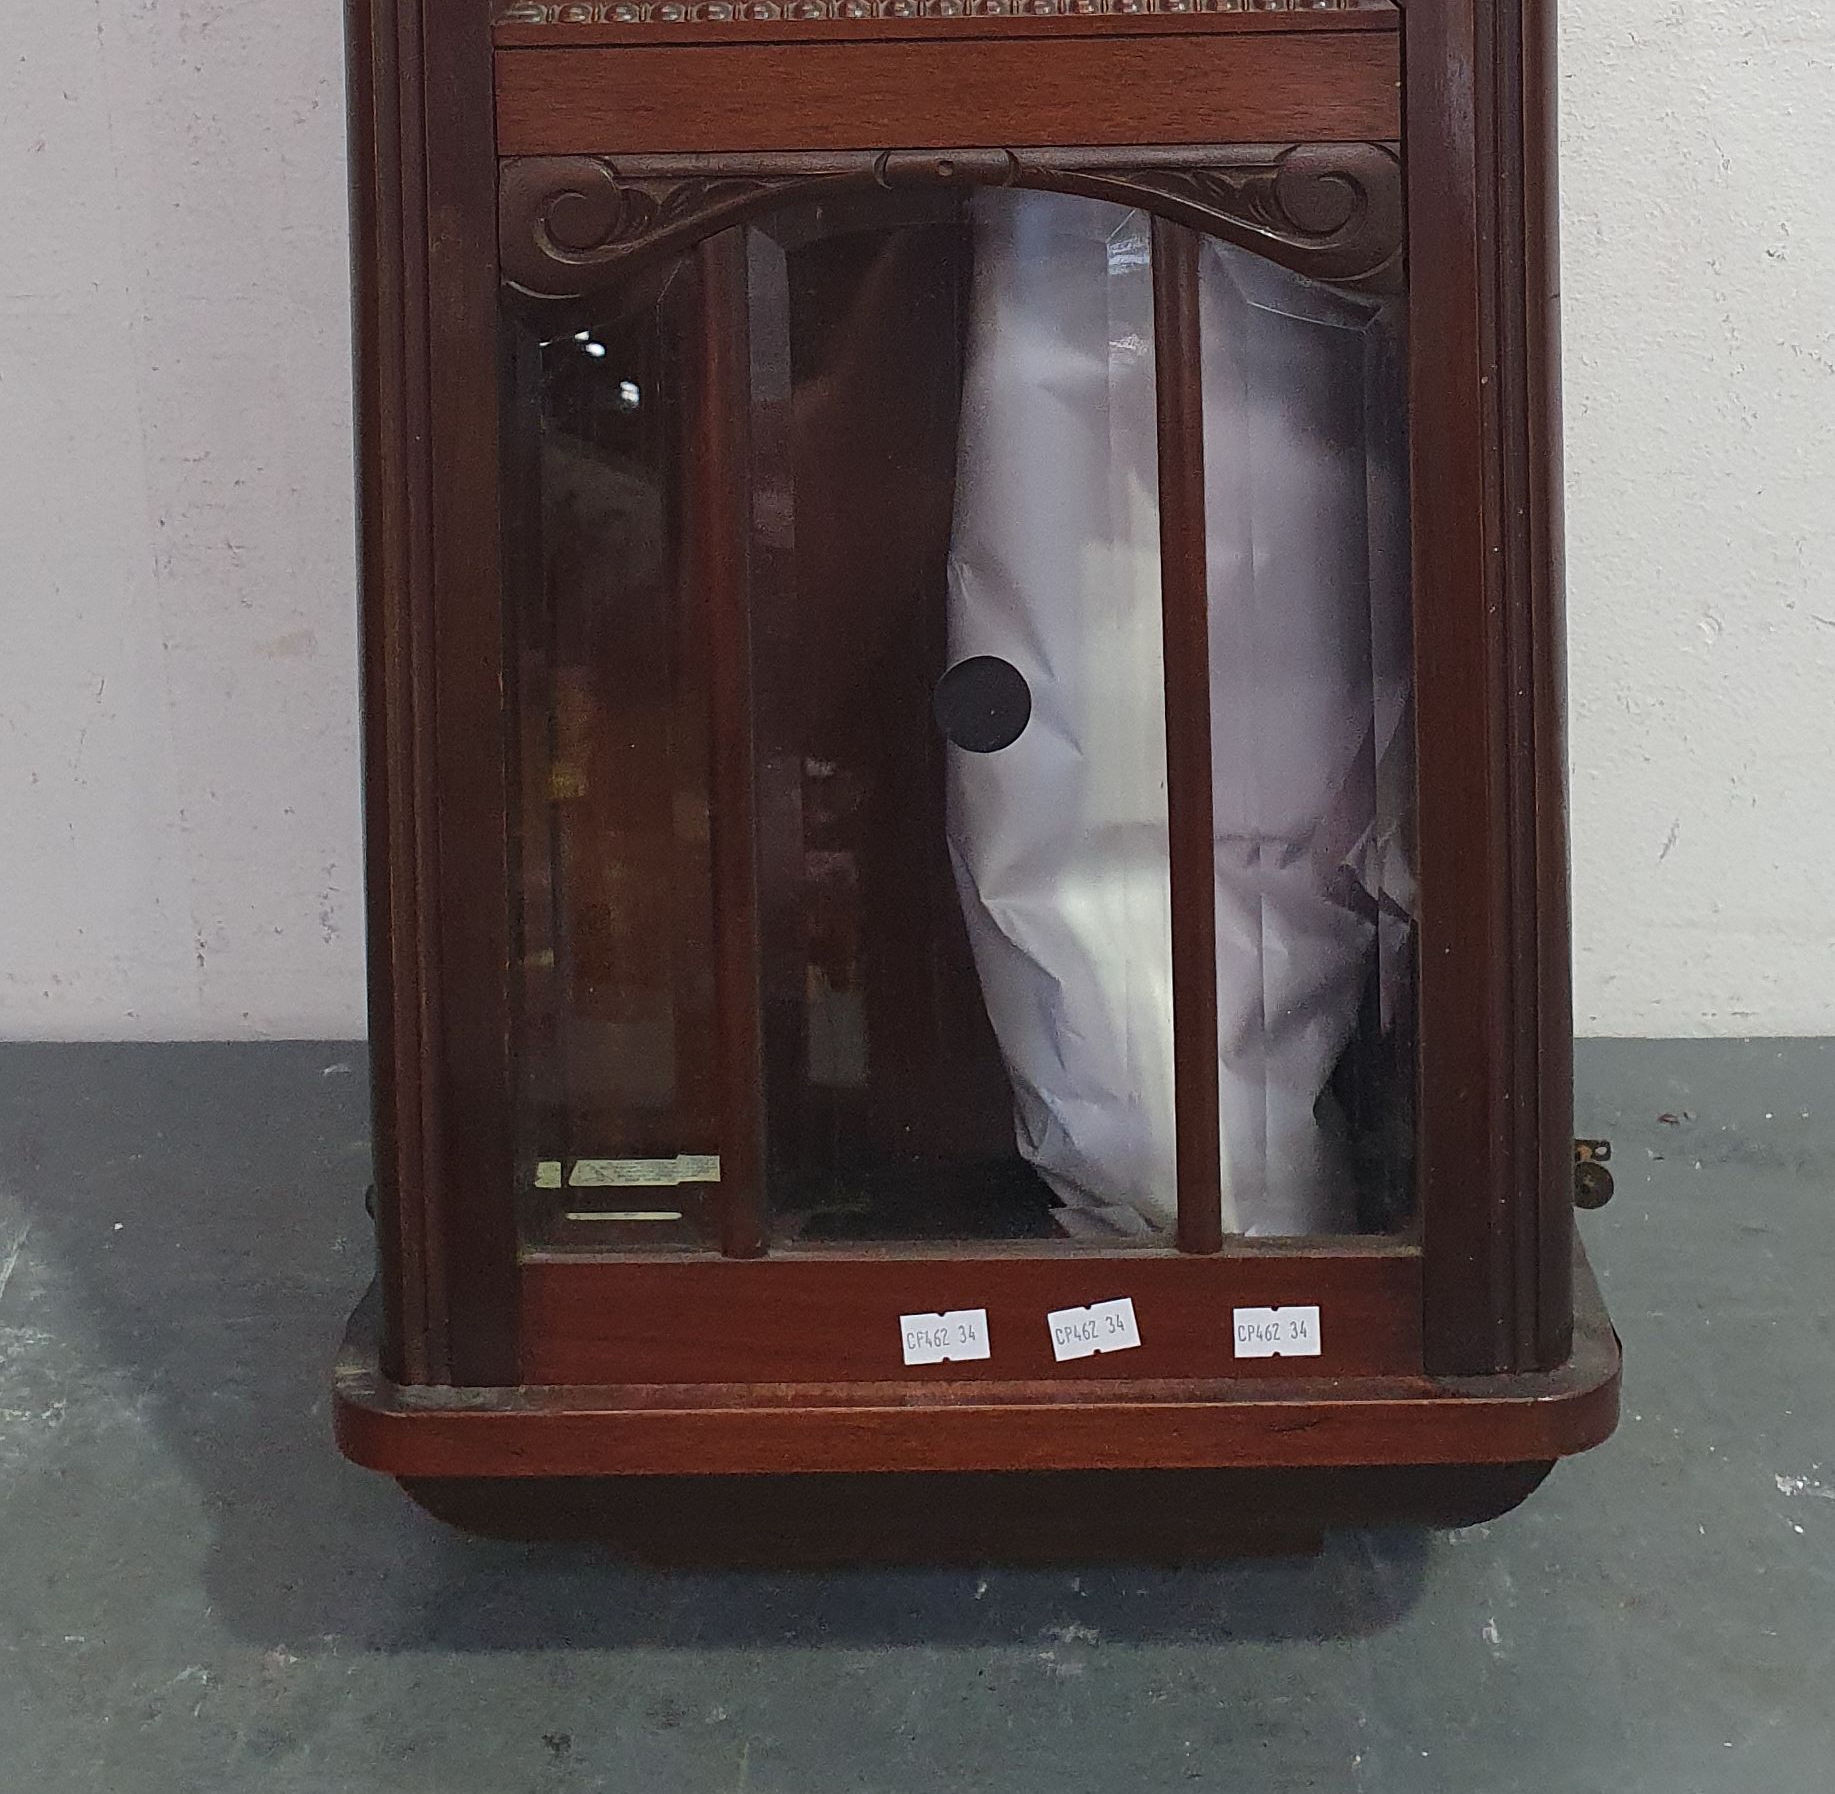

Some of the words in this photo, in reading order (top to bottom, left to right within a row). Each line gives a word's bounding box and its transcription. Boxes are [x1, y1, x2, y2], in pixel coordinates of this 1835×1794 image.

[958, 1325, 976, 1344] 34
[1055, 1320, 1099, 1345] CP462
[1105, 1314, 1125, 1334] 34
[1237, 1322, 1280, 1342] CP462
[1289, 1320, 1307, 1340] 34
